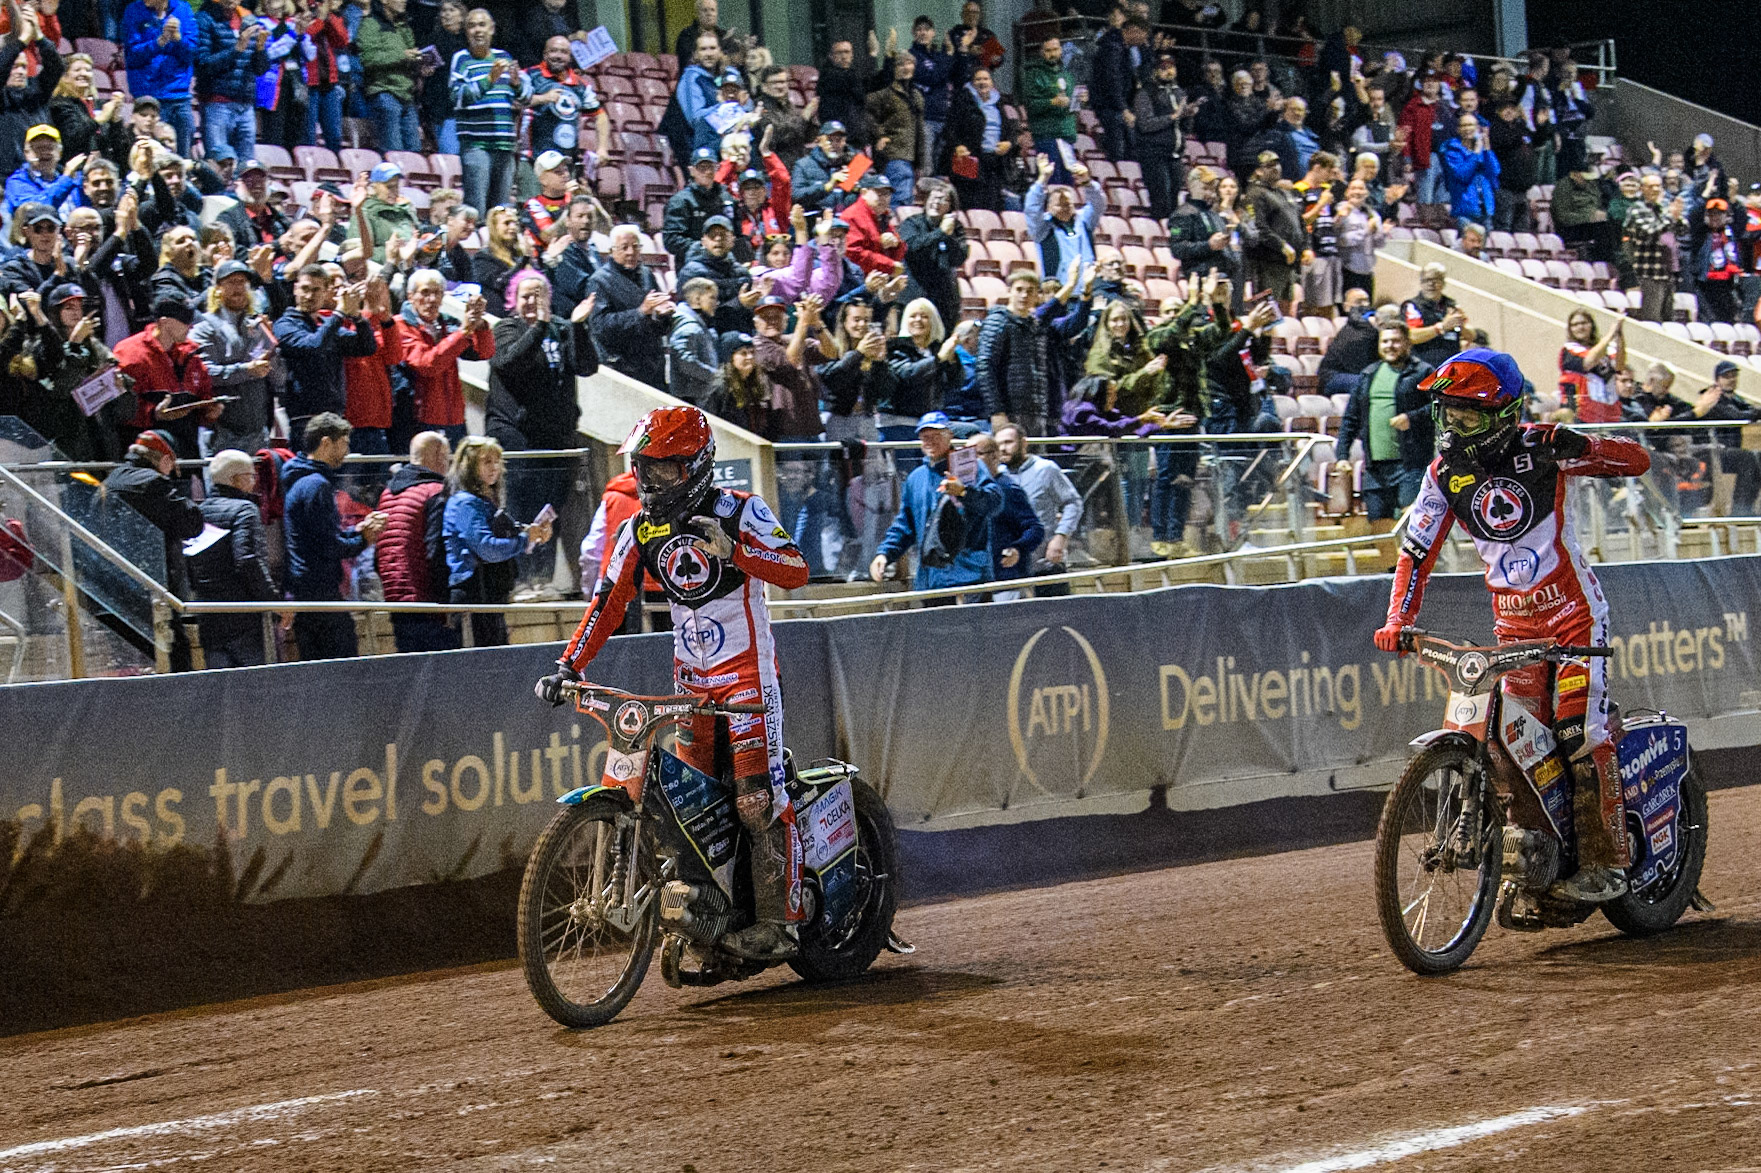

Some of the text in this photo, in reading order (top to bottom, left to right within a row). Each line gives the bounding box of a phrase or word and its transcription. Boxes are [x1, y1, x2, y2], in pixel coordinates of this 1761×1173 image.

[1515, 457, 1530, 471] 5
[1424, 498, 1446, 511] ATPI
[1474, 486, 1489, 511] BELLE
[1507, 484, 1525, 498] ACES
[660, 537, 693, 567] BELLE VUE
[1508, 559, 1532, 574] ATPI
[1158, 651, 1363, 731] Delivering
[763, 683, 778, 757] MASZEWSKI
[1028, 684, 1092, 737] ATPI
[1673, 730, 1681, 751] 5
[209, 743, 397, 840] travel
[422, 724, 610, 816] solutio
[827, 801, 851, 827] CELKA
[1652, 830, 1669, 845] NGK
